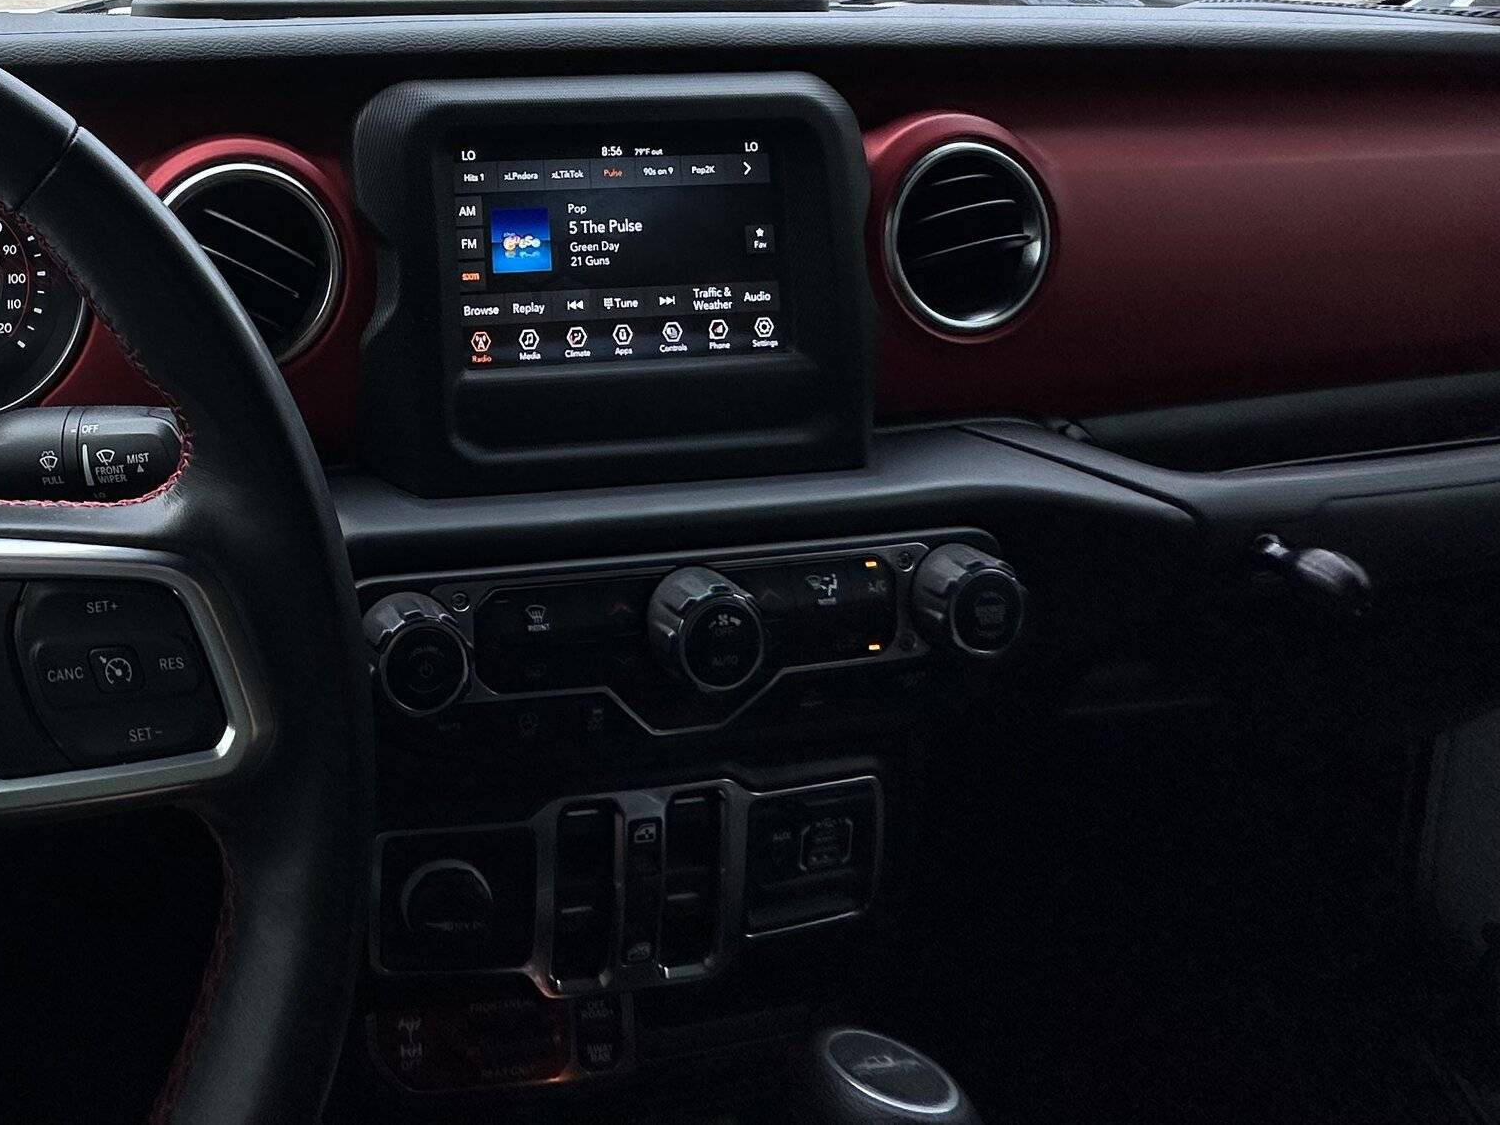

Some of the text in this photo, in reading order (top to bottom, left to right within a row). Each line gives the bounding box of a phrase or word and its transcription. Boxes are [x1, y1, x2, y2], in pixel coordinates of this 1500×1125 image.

[601, 145, 623, 157] 8:56
[744, 141, 759, 153] LO
[461, 150, 476, 161] LO
[603, 168, 623, 178] Pulse
[643, 166, 656, 176] 90s
[668, 166, 674, 175] 9
[691, 164, 716, 175] Pop2K
[463, 173, 479, 182] Hits
[459, 205, 477, 217] AM
[567, 203, 587, 215] Pop
[569, 218, 643, 235] 5 The Pulse
[461, 238, 477, 249] FM
[570, 241, 620, 253] Green Day
[754, 240, 768, 249] Fav
[2, 244, 17, 256] 90
[570, 255, 611, 267] 21 Guns
[7, 277, 26, 289] 100
[693, 286, 732, 298] Traffic &
[743, 291, 771, 302] Audio
[7, 299, 22, 310] 110
[512, 302, 545, 315] Replay
[614, 298, 639, 308] Tune
[693, 299, 733, 311] Weather
[463, 305, 500, 316] Browse
[659, 344, 688, 353] Controls
[709, 341, 731, 350] Phone
[752, 338, 779, 348] Settings
[519, 352, 542, 361] Media
[564, 349, 592, 359] Climate
[614, 347, 633, 356] Apps
[472, 354, 492, 364] Radio
[81, 424, 99, 435] OFF
[126, 451, 150, 464] MIST
[95, 464, 125, 476] FRONT
[42, 475, 66, 486] PULL
[97, 473, 128, 485] WIPER
[86, 600, 119, 614] SET+
[158, 656, 185, 671] RES
[47, 666, 84, 683] CANC
